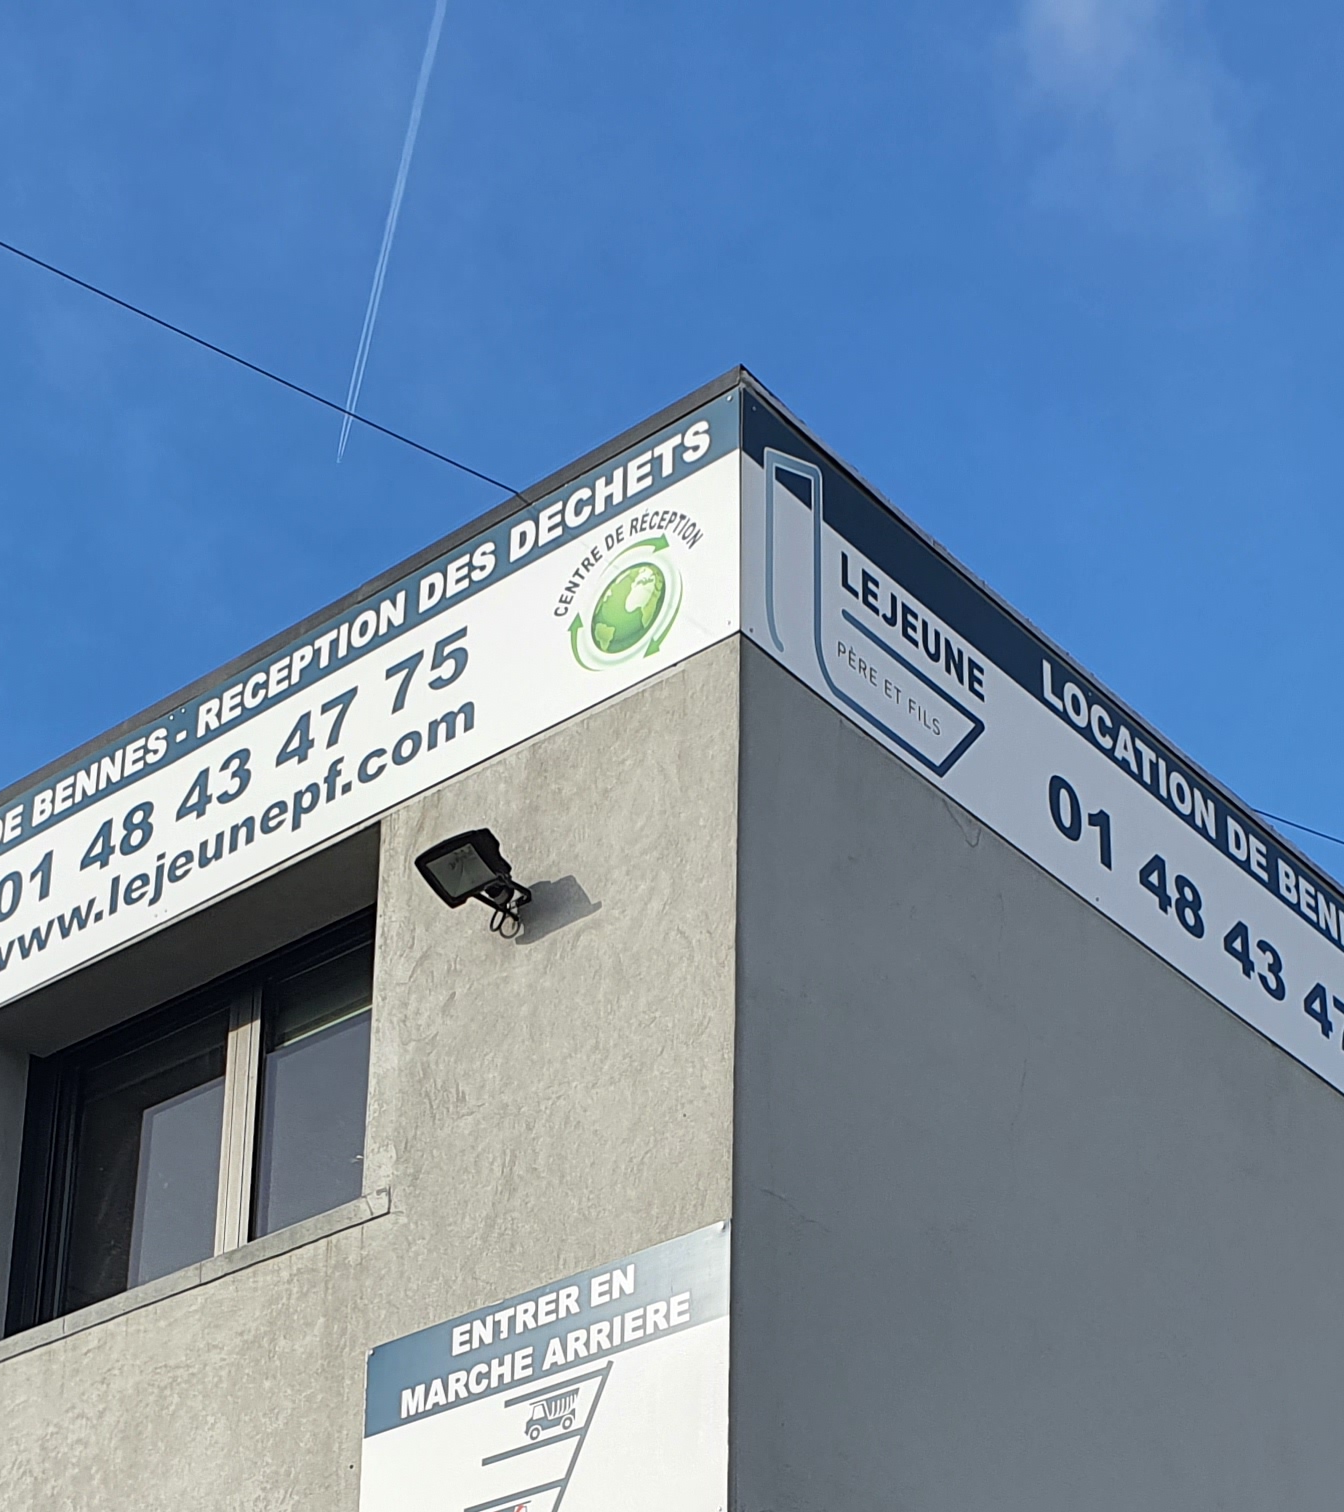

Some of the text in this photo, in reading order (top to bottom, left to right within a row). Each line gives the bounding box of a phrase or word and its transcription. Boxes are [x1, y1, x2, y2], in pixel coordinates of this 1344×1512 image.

[32, 727, 168, 827] BENNES
[197, 590, 405, 738] RECEPTION
[419, 541, 496, 614] DES
[509, 420, 710, 563] DECHETS
[553, 509, 703, 618] CENTRE DE RÉCEPTION
[841, 551, 985, 703] LEJEUNE
[79, 801, 155, 871] 48
[175, 747, 252, 822] 43
[275, 685, 358, 768] 47
[385, 625, 469, 714] 75
[837, 640, 942, 736] PÈRE ET FILS
[1042, 658, 1216, 839] LOCATION
[1227, 815, 1268, 882] DE
[1048, 775, 1113, 871] 01
[1139, 853, 1205, 939] 48
[1223, 920, 1286, 1001] 43
[400, 1291, 692, 1419] MARCHE ARRIERE
[451, 1263, 635, 1357] ENTRER EN
